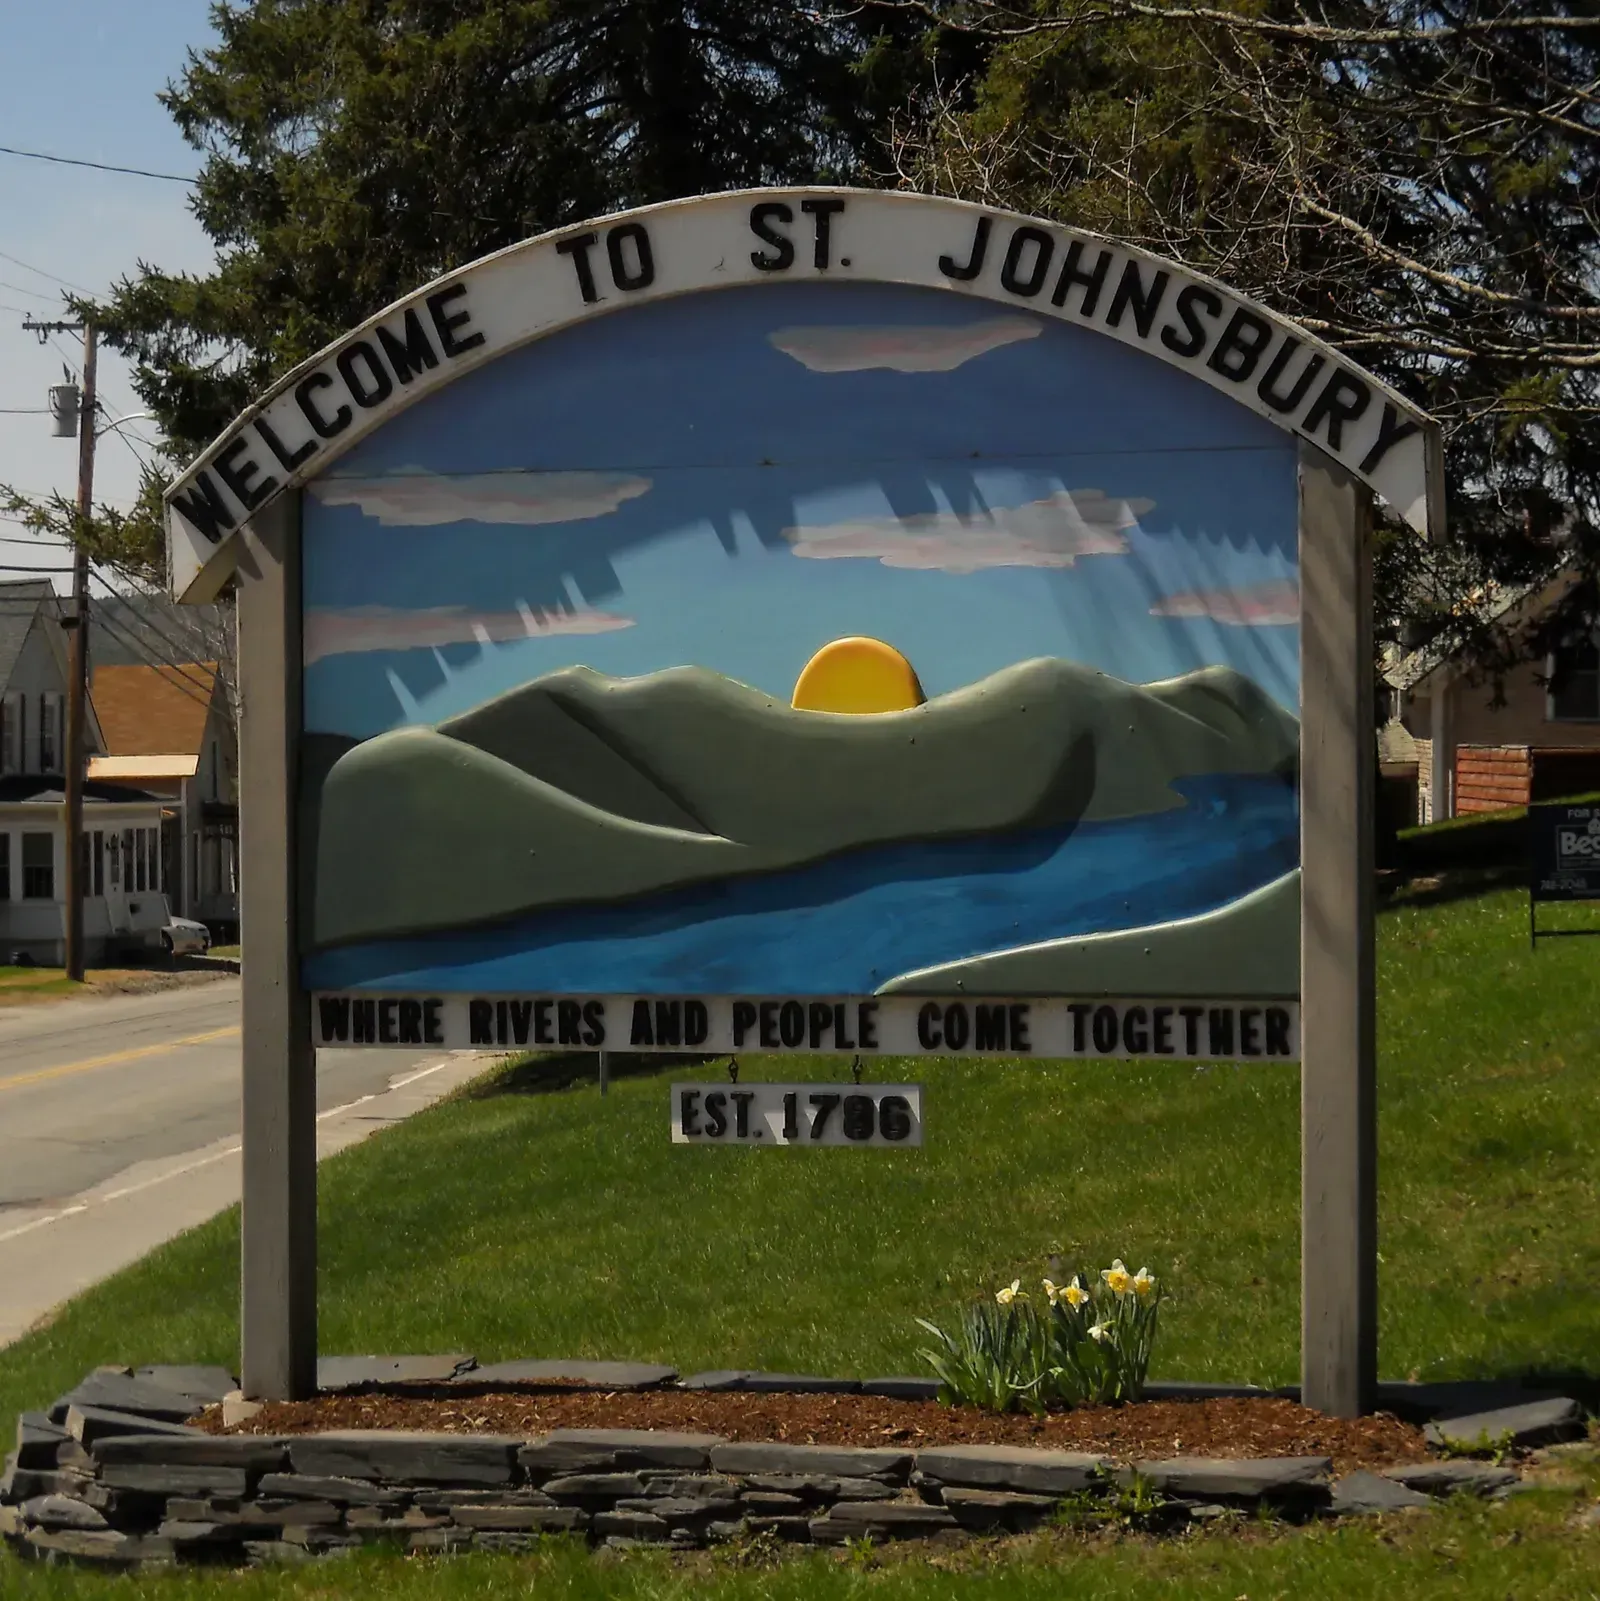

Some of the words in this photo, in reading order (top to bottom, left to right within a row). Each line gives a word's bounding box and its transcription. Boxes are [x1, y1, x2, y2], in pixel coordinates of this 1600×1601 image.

[170, 284, 486, 544] WELCOME
[555, 222, 655, 306] TO
[749, 199, 851, 273] ST.
[939, 217, 1419, 475] JOHNSBURY
[319, 997, 445, 1044] WHERE
[469, 1000, 606, 1046] RIVERS
[630, 1000, 708, 1046] AND
[733, 1001, 879, 1049] PEOPLE
[917, 1003, 1032, 1052] COME
[1067, 1004, 1291, 1056] TOGETHER
[681, 1090, 763, 1138] EST.
[783, 1091, 911, 1140] 1786
